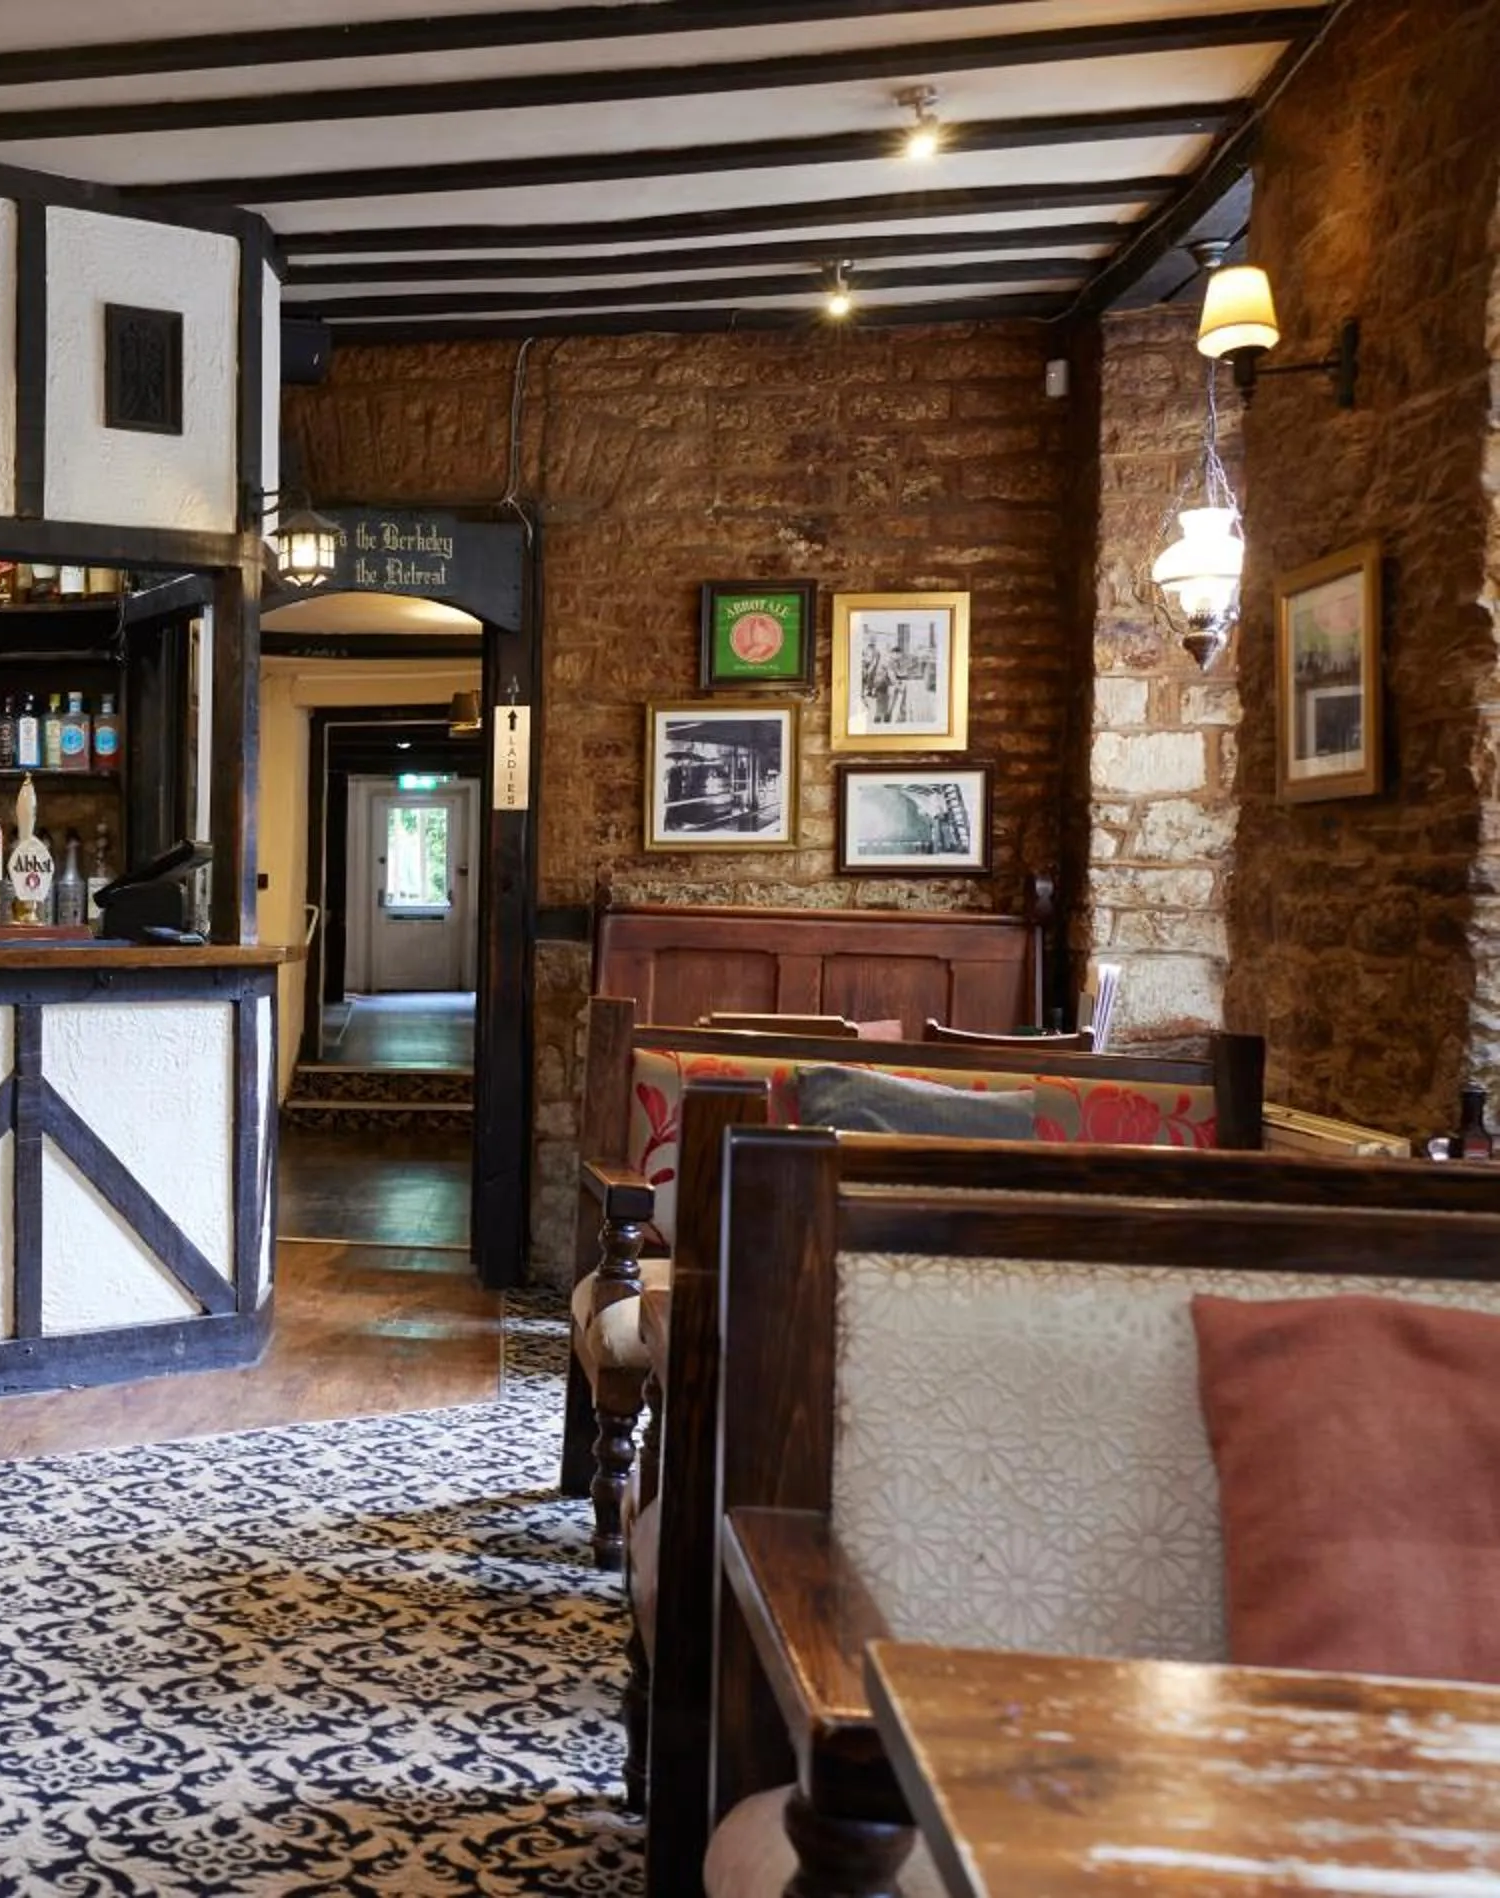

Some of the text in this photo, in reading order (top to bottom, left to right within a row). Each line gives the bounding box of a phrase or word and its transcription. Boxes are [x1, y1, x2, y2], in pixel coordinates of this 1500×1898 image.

[355, 522, 377, 550] the
[379, 522, 453, 559] Berkeley
[355, 557, 446, 588] the Retreat
[507, 735, 517, 805] LADIES
